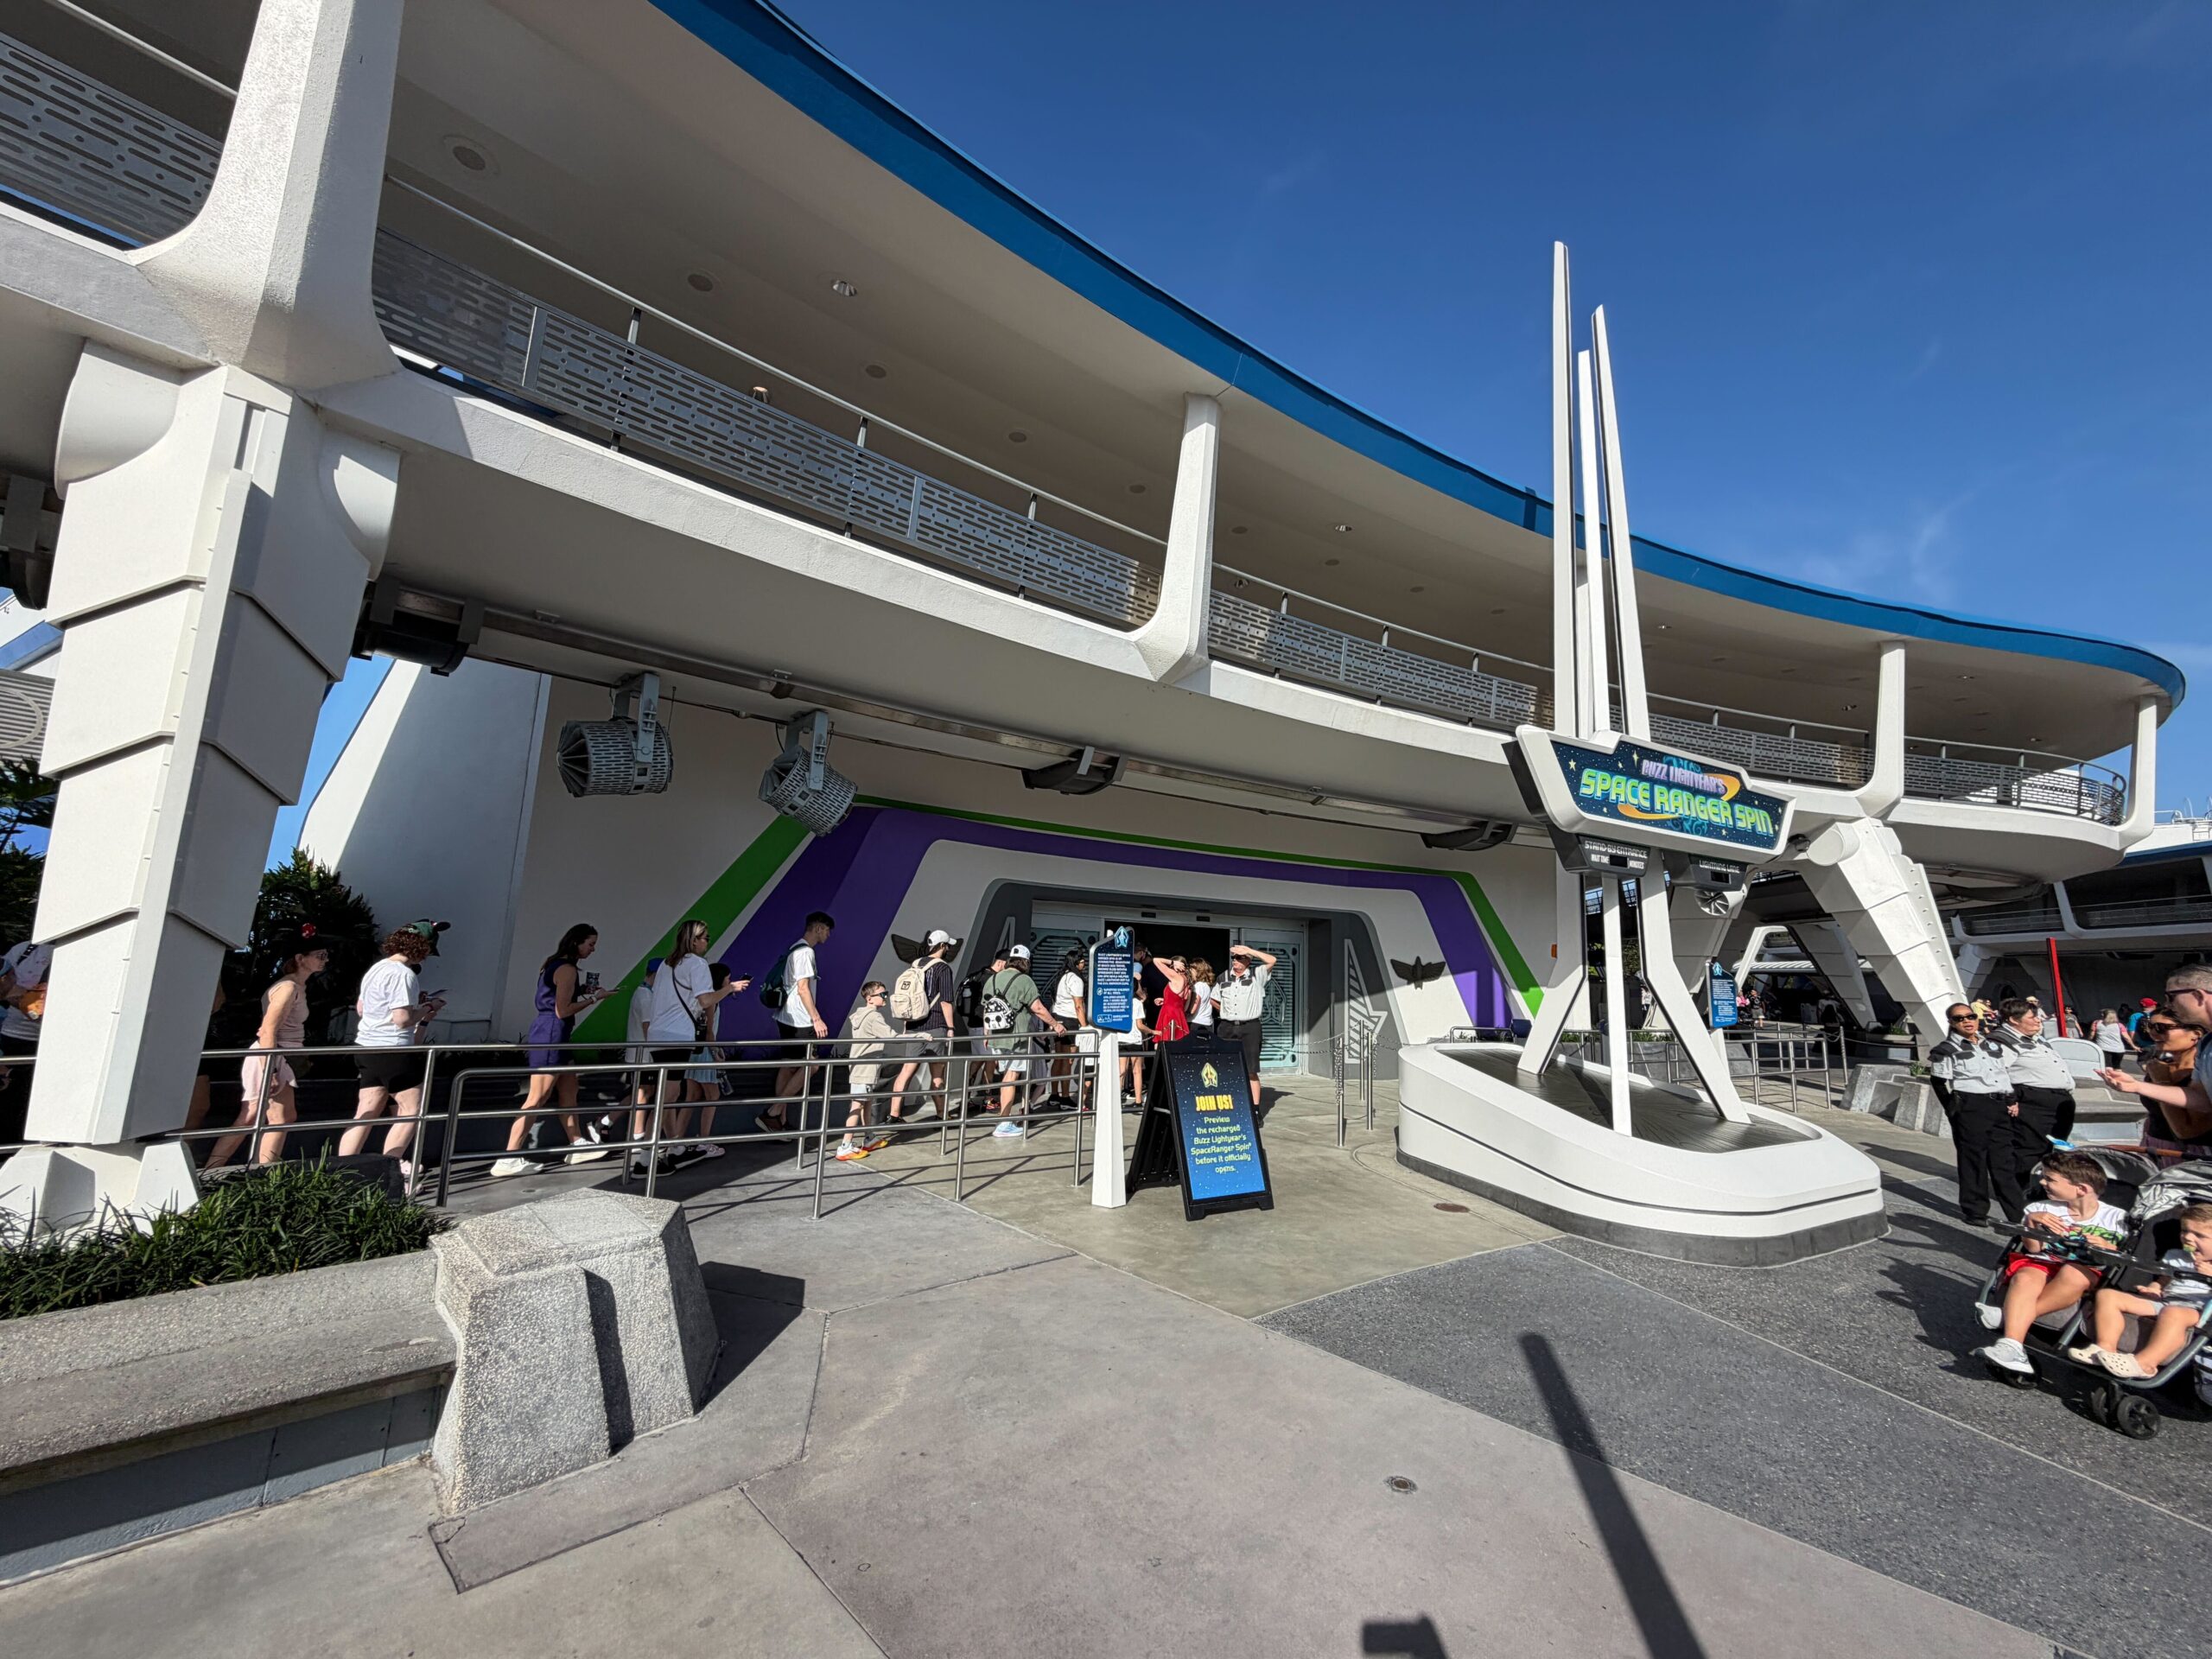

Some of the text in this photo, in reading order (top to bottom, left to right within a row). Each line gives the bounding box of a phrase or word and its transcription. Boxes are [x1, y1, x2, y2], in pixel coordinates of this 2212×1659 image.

[1642, 760, 1726, 794] BUZZ LIGHTYEAR'S
[1580, 768, 1774, 836] SPACE RANGER SPIN
[1617, 846, 1648, 859] ENTRANCE
[1195, 1094, 1234, 1111] JOIN US!
[1208, 1124, 1241, 1133] recharged
[1211, 1134, 1246, 1144] Lightyear's
[1195, 1156, 1217, 1165] before
[1224, 1153, 1251, 1162] officially
